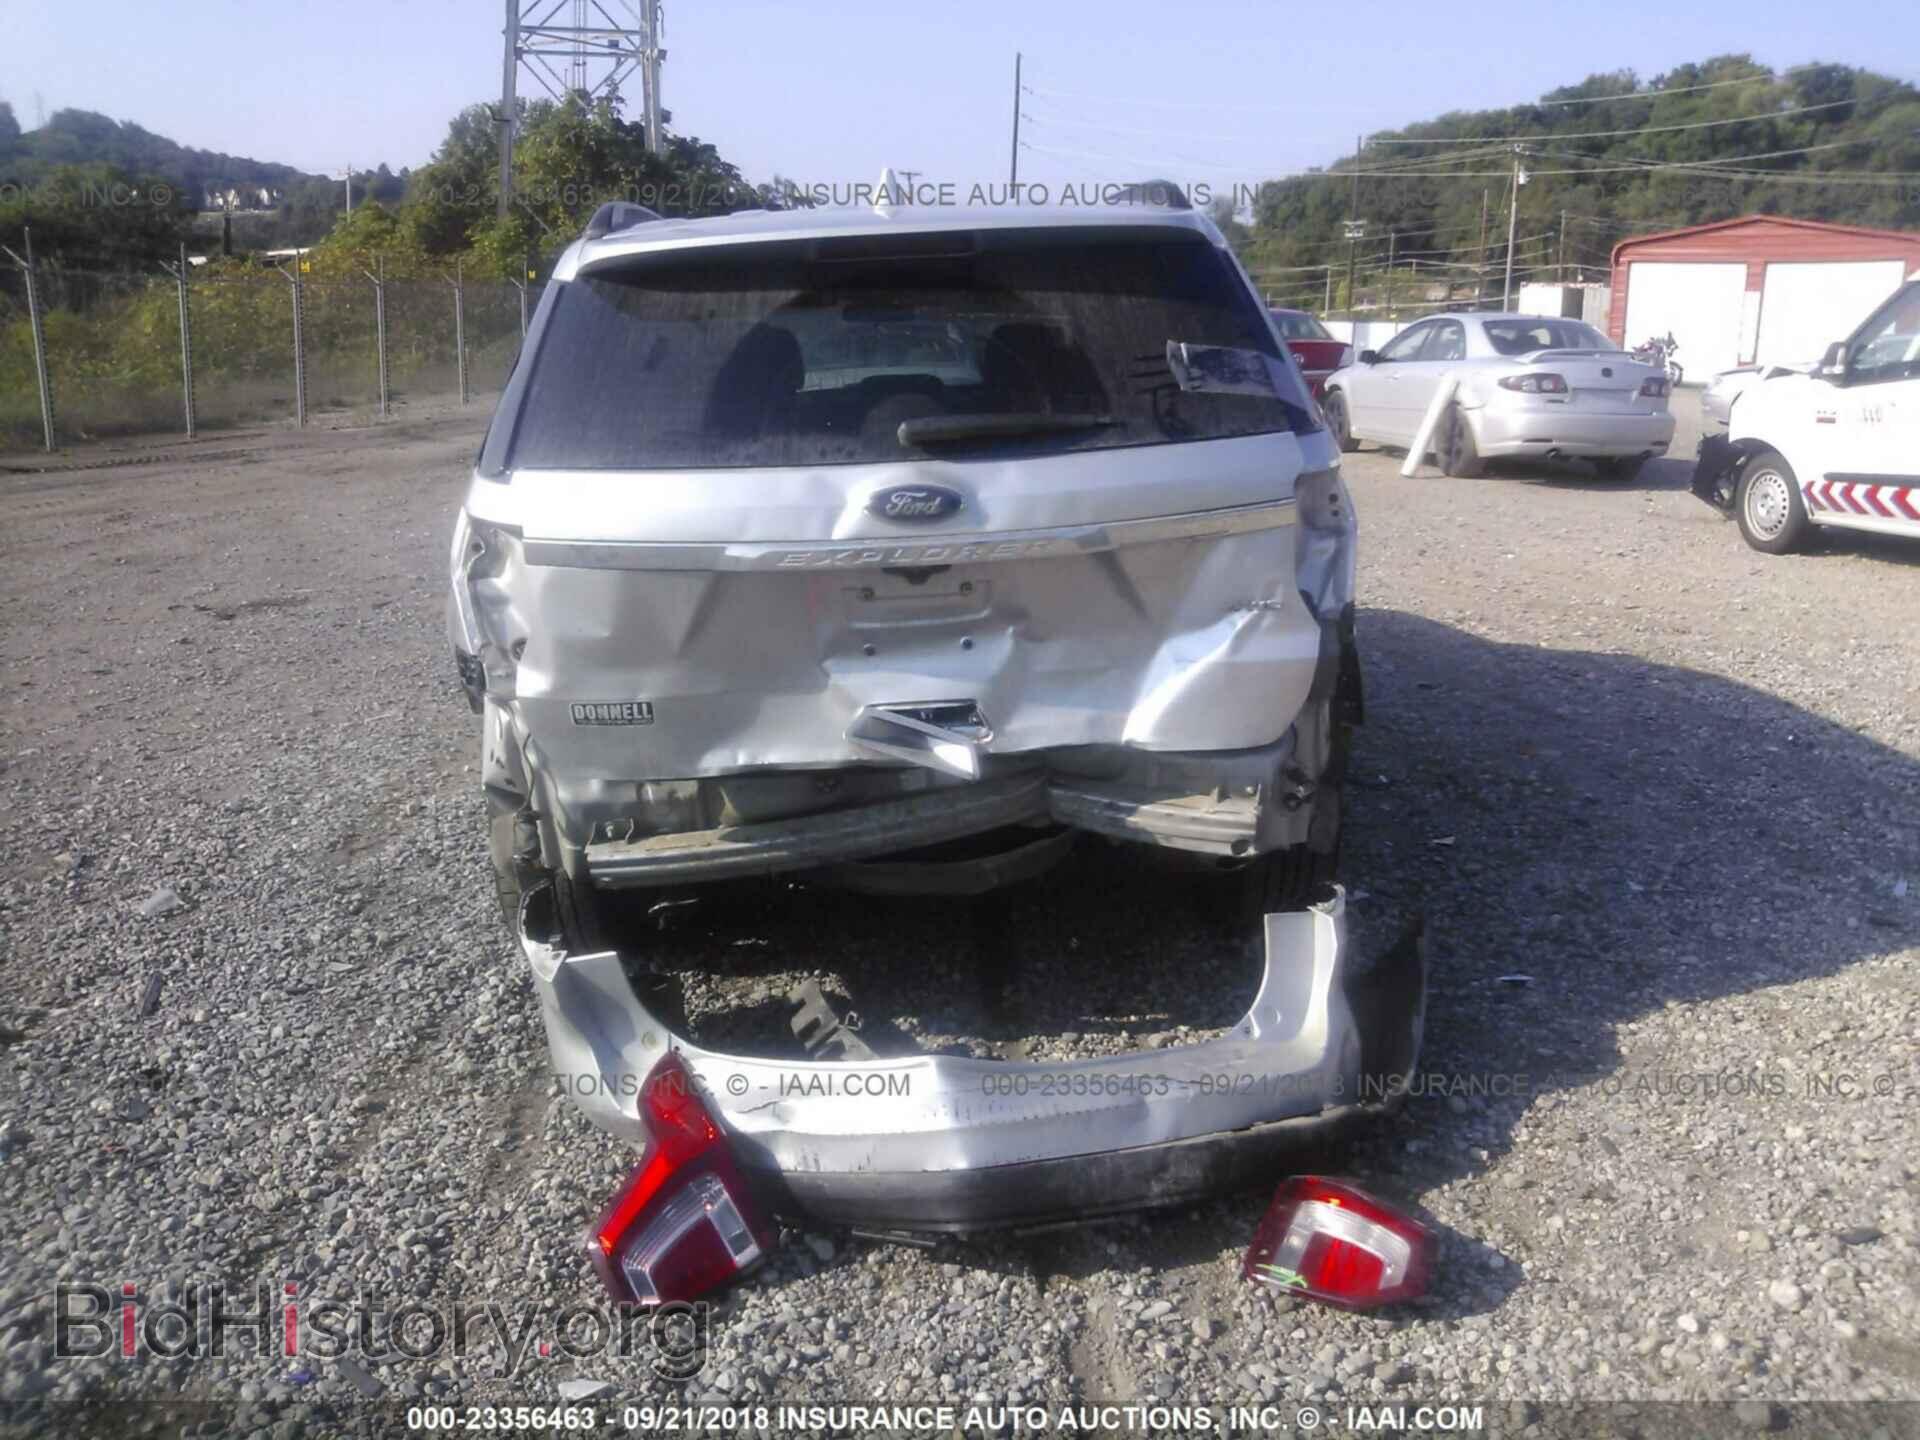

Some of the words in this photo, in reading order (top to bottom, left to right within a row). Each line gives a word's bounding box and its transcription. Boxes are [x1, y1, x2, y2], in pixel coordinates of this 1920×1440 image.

[885, 491, 941, 515] Ford
[776, 538, 1051, 567] EXPLORER
[573, 702, 652, 720] DONNELL
